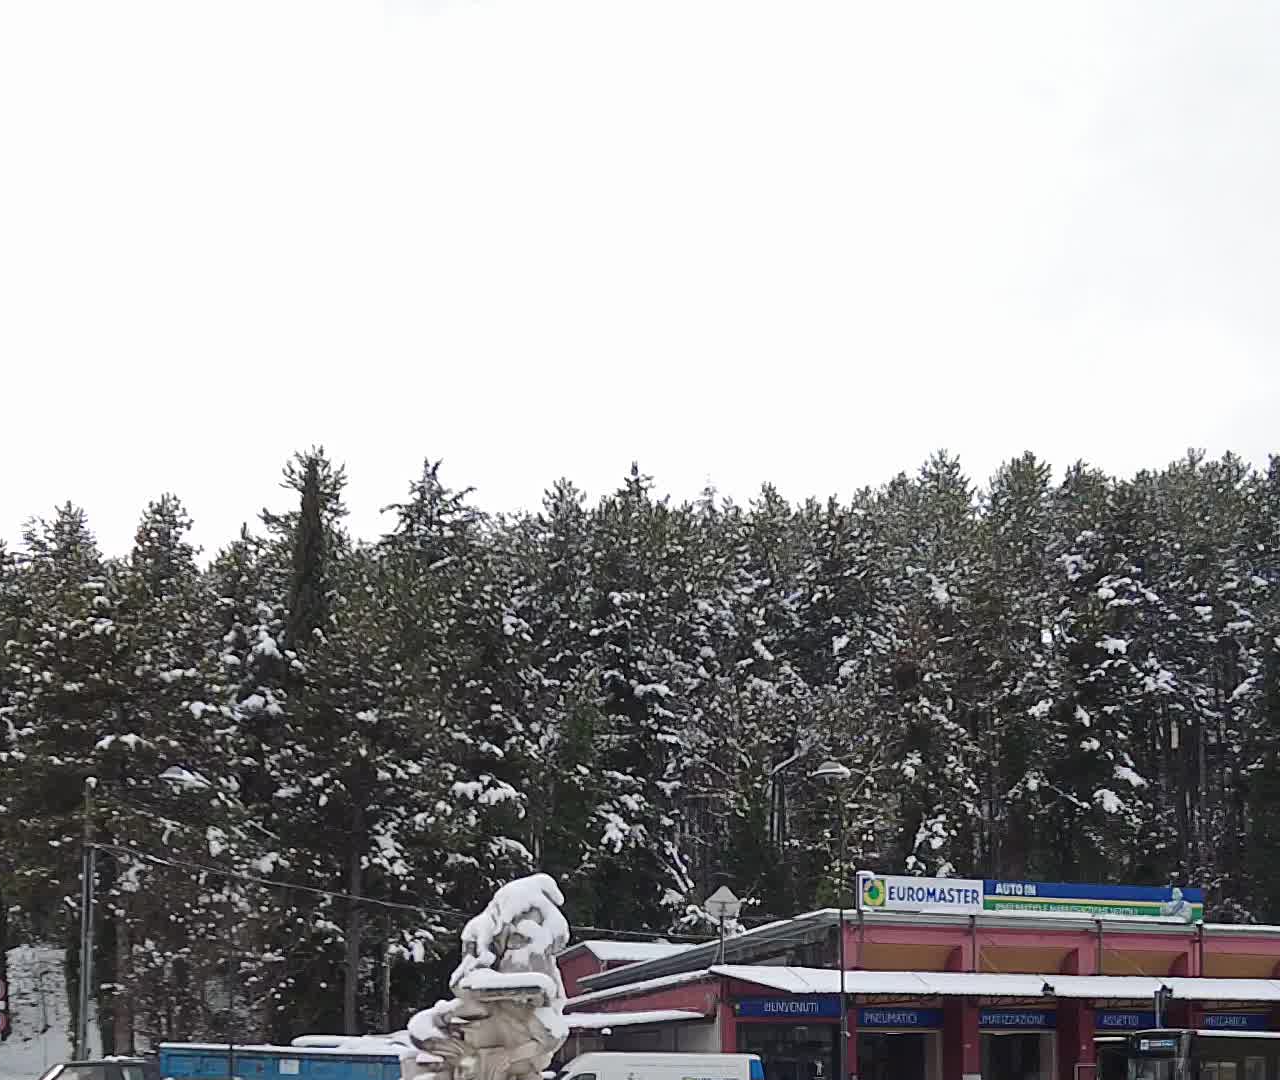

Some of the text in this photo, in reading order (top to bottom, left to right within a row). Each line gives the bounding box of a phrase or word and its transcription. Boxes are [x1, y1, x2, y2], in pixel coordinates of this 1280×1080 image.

[888, 885, 980, 904] EUROMASTER
[994, 883, 1022, 895] AUTO
[764, 1002, 819, 1013] BENVENUTI
[863, 1012, 918, 1025] PNEUMATICI
